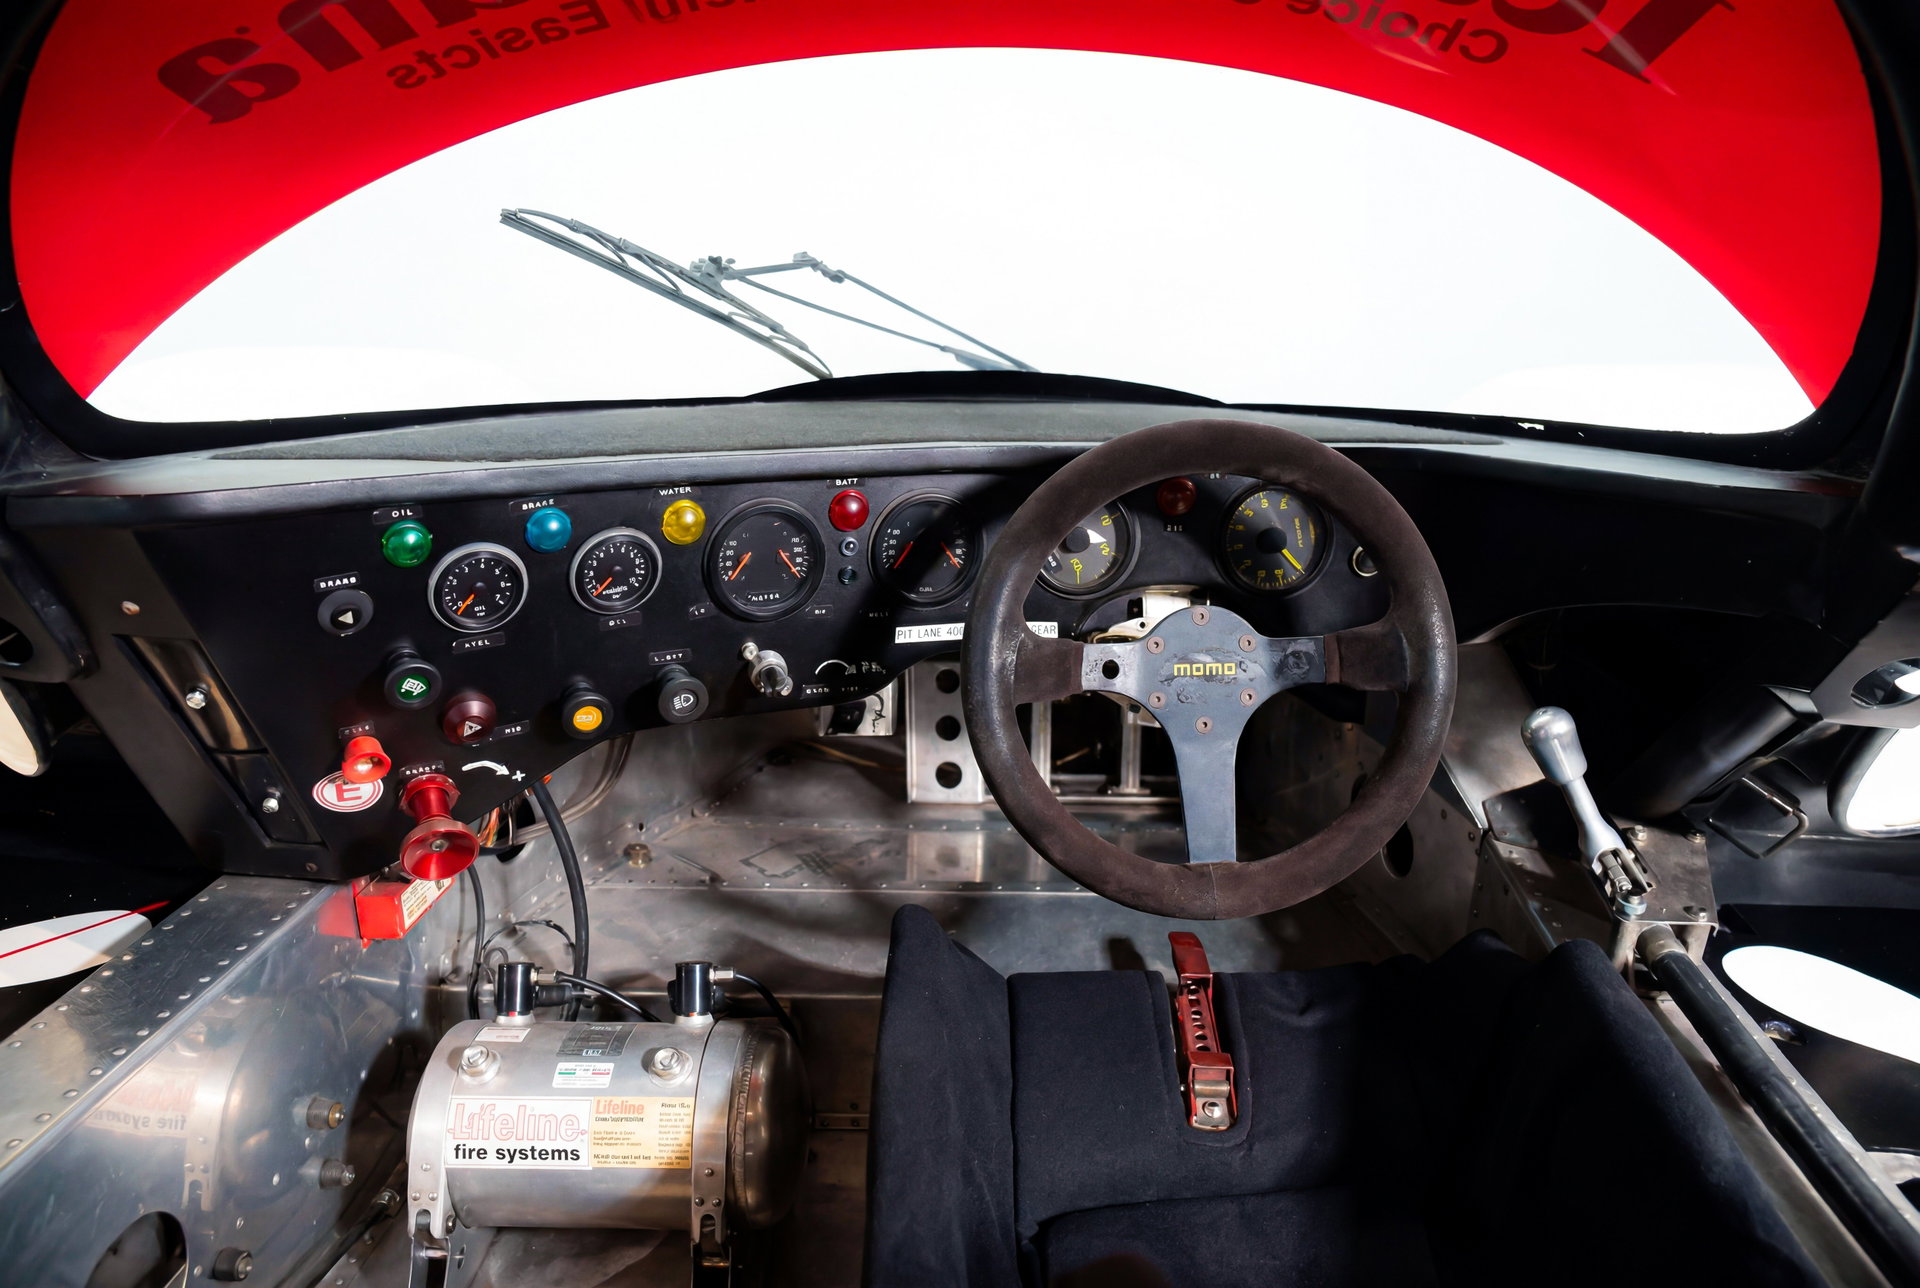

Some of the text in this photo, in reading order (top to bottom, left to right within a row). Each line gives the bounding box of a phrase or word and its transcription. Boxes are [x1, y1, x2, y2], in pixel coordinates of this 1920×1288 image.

[835, 477, 858, 487] BATT
[659, 485, 692, 496] WATER
[391, 508, 413, 518] OIL
[896, 629, 912, 640] PIT
[918, 627, 941, 638] LANE
[1031, 624, 1056, 634] GEAR
[334, 781, 363, 803] E
[595, 1099, 645, 1115] Lifeline
[453, 1103, 581, 1141] Lifeline
[454, 1143, 488, 1160] fire
[495, 1145, 581, 1164] systems
